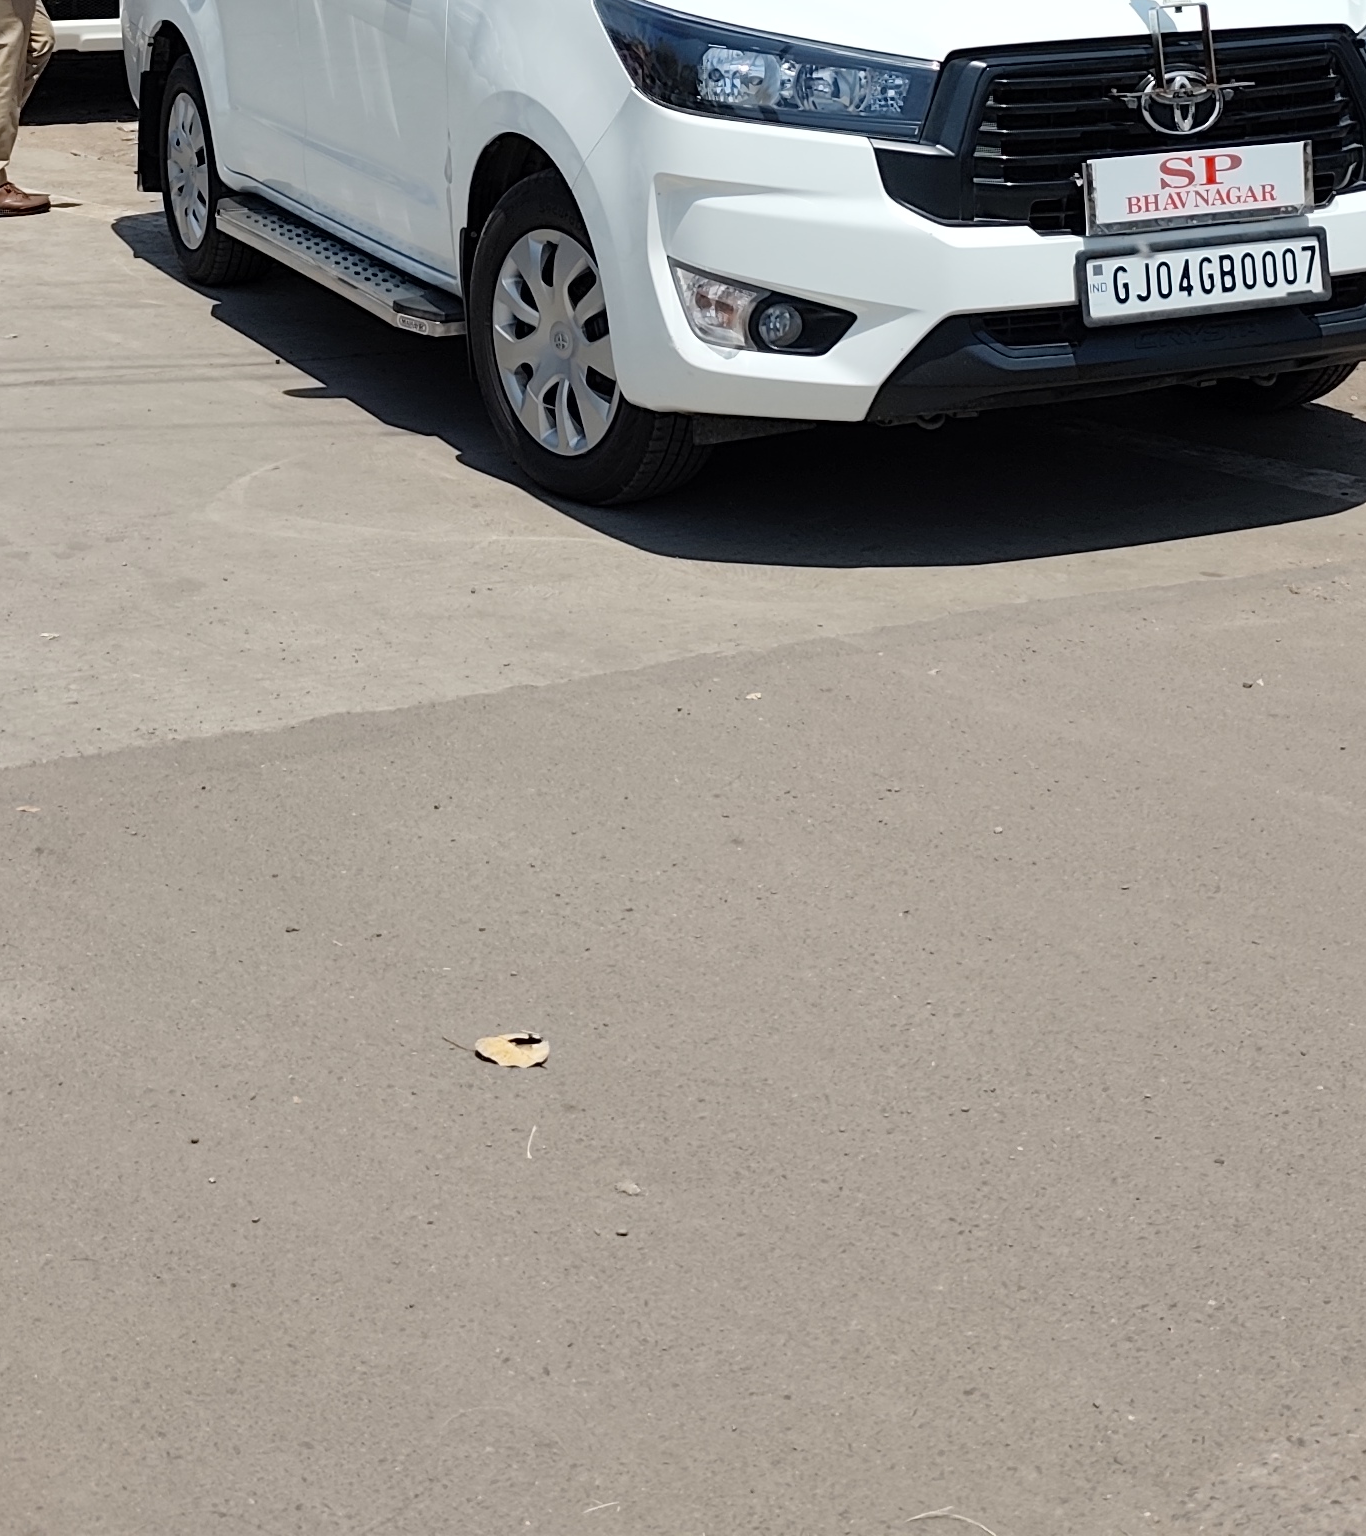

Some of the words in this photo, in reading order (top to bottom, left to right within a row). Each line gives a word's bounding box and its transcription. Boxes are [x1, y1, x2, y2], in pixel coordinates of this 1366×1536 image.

[1159, 153, 1243, 190] SP
[1125, 183, 1278, 215] BHAVNAGAR
[1089, 282, 1108, 294] IND
[1112, 245, 1317, 305] GJ04GB0007
